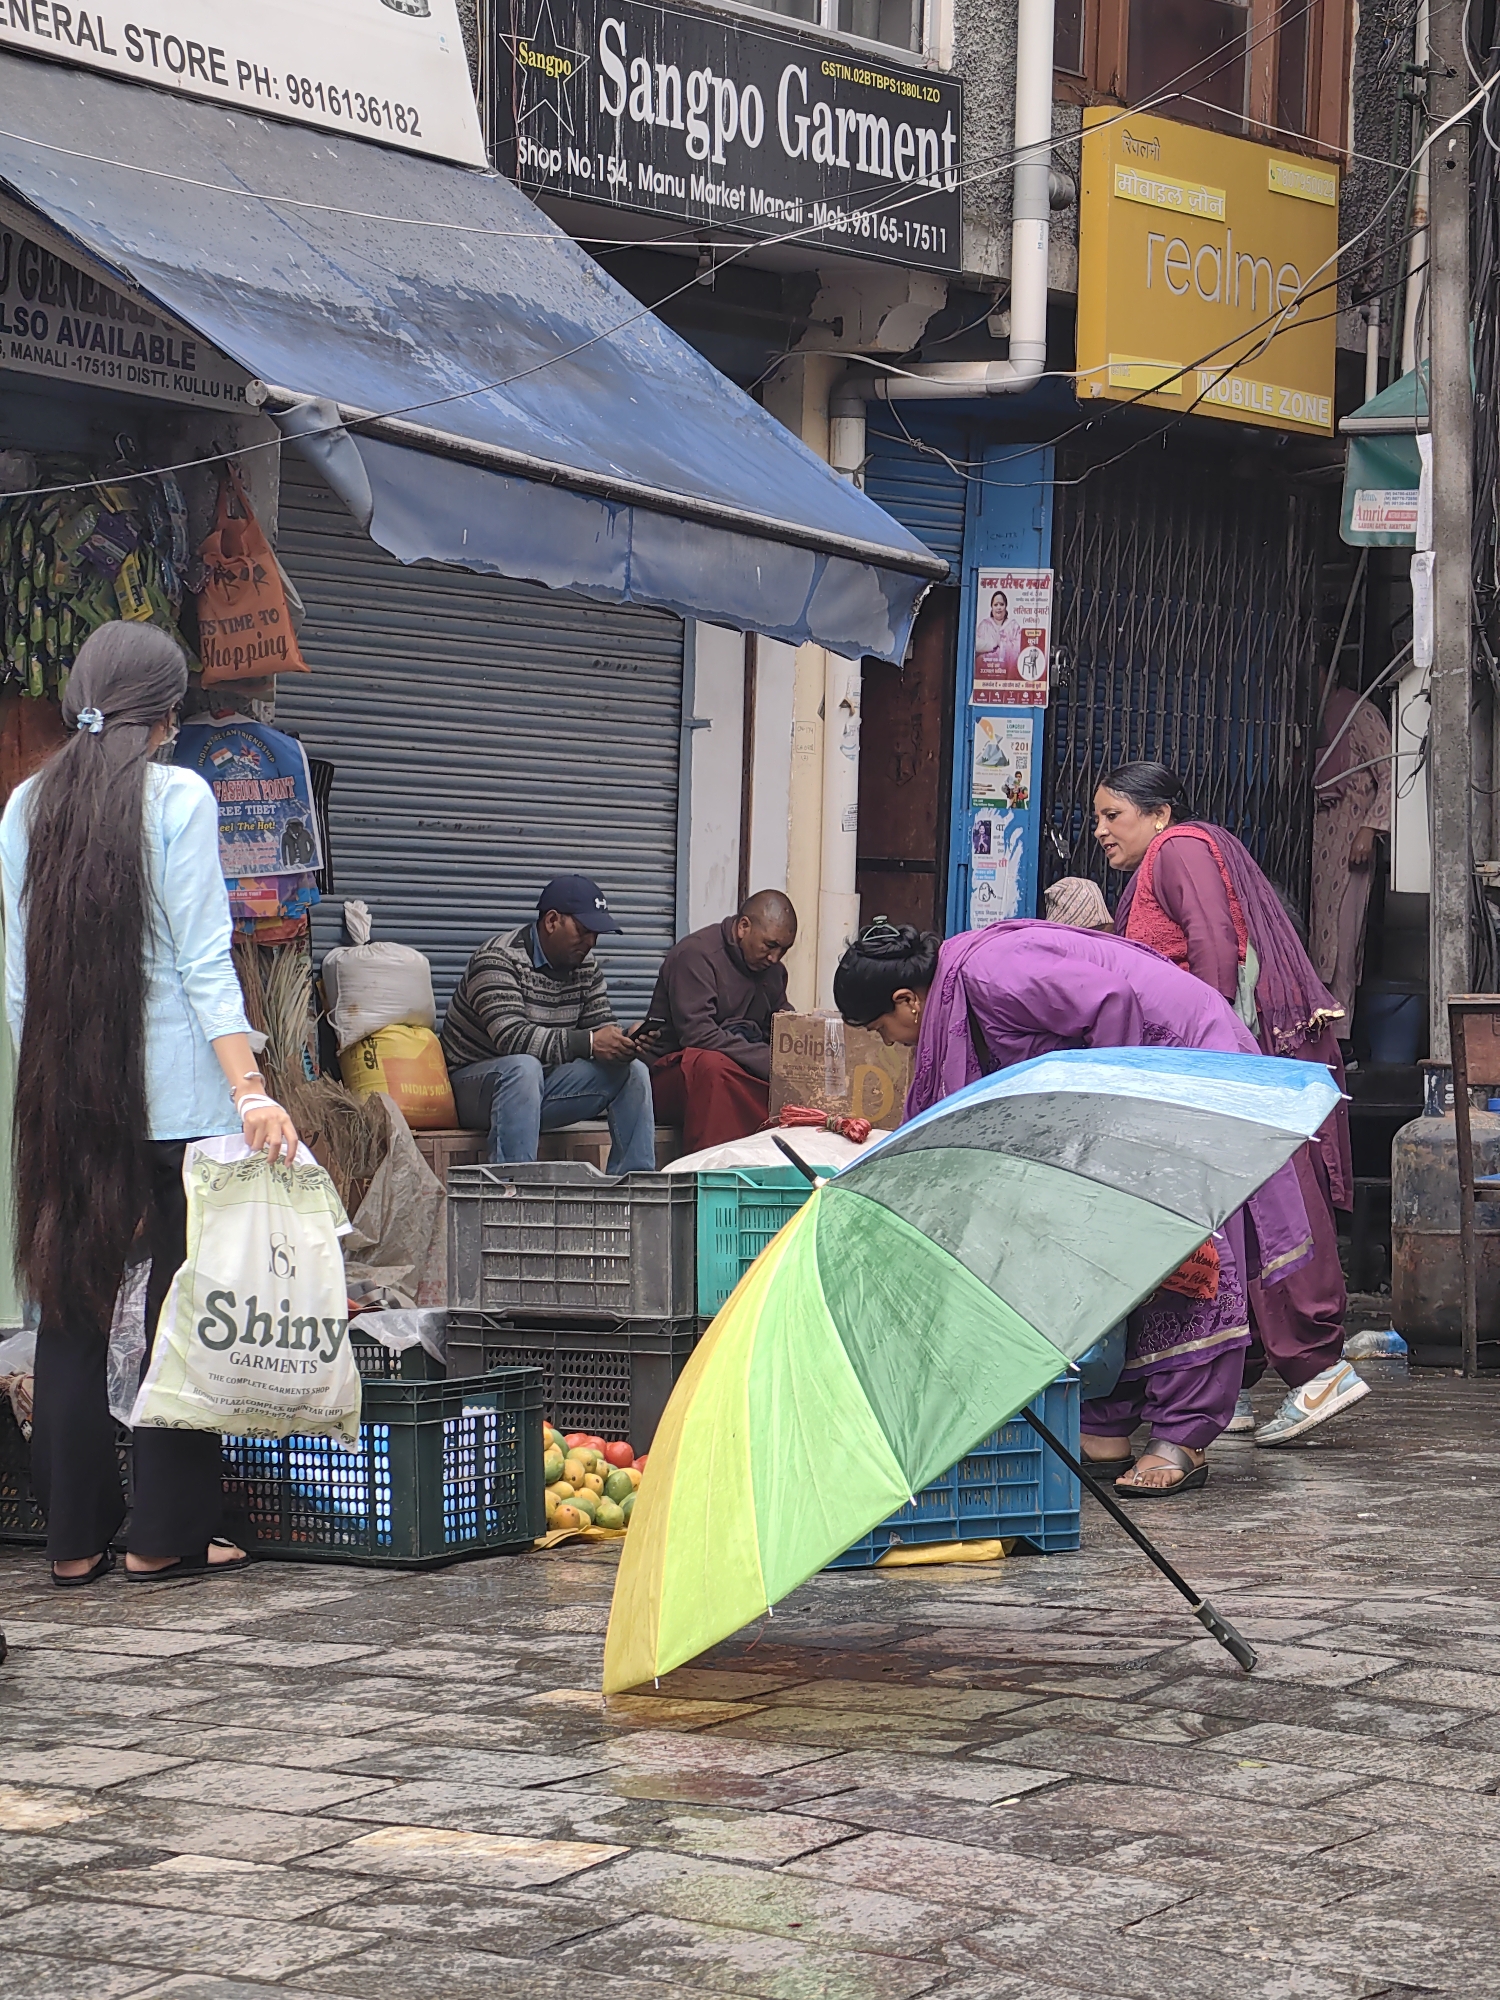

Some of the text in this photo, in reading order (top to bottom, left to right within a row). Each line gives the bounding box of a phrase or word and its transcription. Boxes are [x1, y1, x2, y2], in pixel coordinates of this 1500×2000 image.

[518, 41, 572, 78] Sangpo
[124, 23, 229, 87] STORE
[236, 59, 280, 100] PH:
[286, 73, 422, 137] 9816136182
[600, 17, 957, 193] Sangpo Garment
[518, 136, 562, 176] Shop
[638, 162, 686, 199] Manu
[690, 173, 746, 212] Market
[750, 187, 803, 224] Manali
[1117, 169, 1184, 205] मोबाइल
[1146, 227, 1302, 320] realme
[56, 315, 197, 372] AVAILABLE
[10, 341, 68, 369] MANALI
[126, 365, 170, 389] DISTT.
[173, 373, 220, 398] KULLU
[1201, 371, 1329, 425] MOBILE ZONE
[1354, 504, 1384, 522] Amrit
[218, 613, 255, 635] TIME
[258, 607, 280, 625] TO
[202, 631, 290, 671] Shopping
[261, 776, 296, 801] POINT
[218, 804, 277, 817] REE TIBET
[236, 822, 255, 831] The
[257, 820, 276, 830] Hot!
[400, 1082, 435, 1097] INDIA'S
[197, 1290, 349, 1364] Shiny
[229, 1351, 318, 1374] GARMENTS
[208, 1372, 330, 1396] THE COMPLETE GARMENTS SHOP
[220, 1397, 245, 1406] PLAZA
[324, 1408, 343, 1417] (HP)
